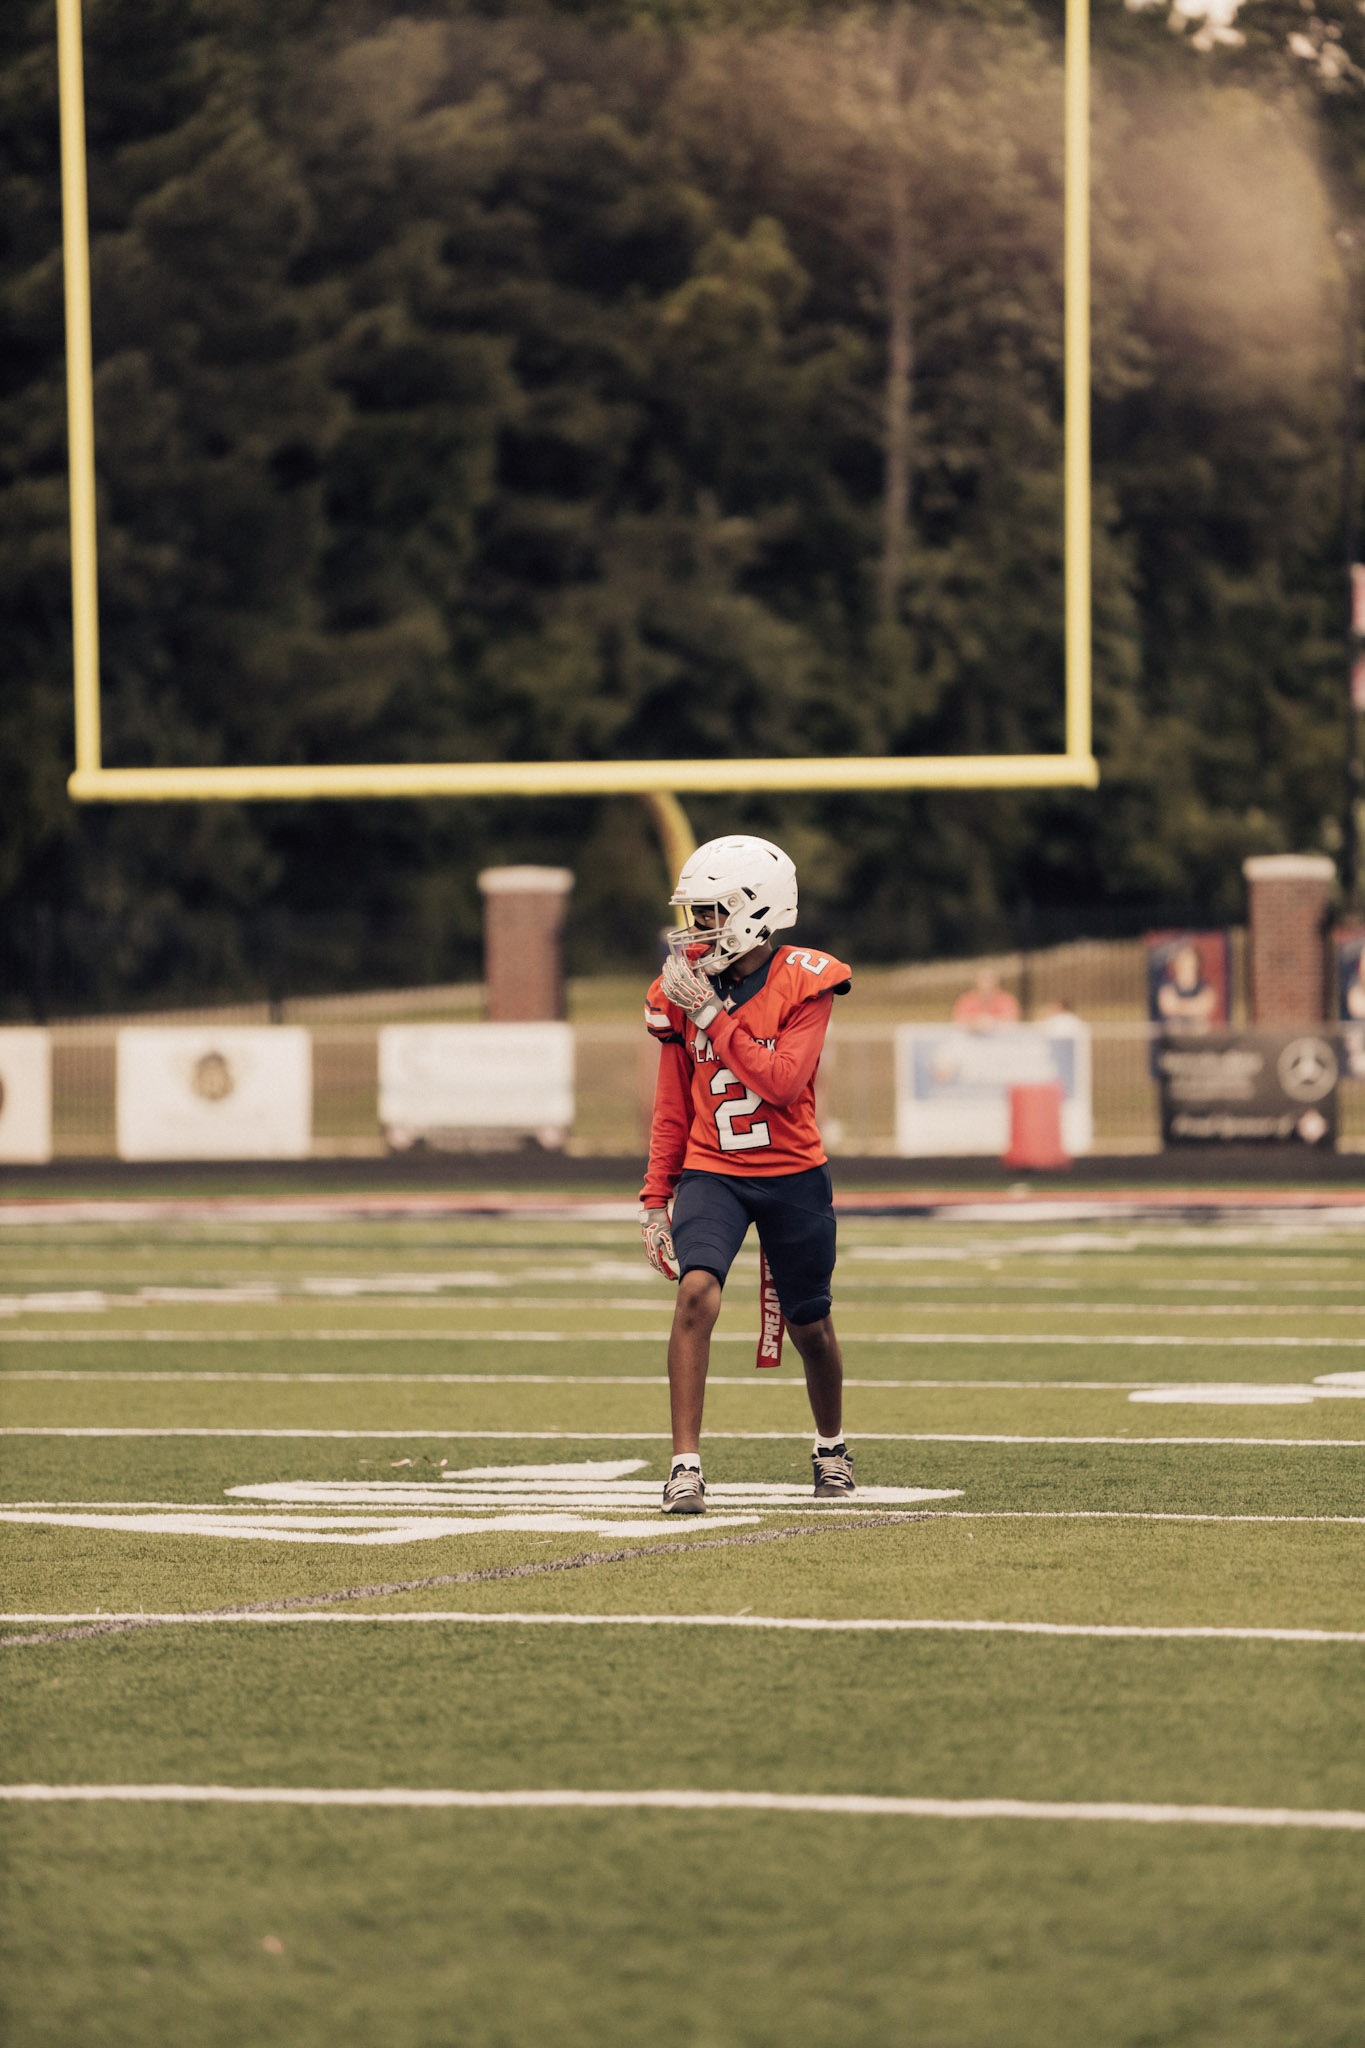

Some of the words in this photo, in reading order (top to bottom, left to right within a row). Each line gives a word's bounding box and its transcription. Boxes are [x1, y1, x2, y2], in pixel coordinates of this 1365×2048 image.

[785, 950, 830, 976] 2
[710, 1067, 771, 1151] 2
[761, 1287, 781, 1359] SPREAD
